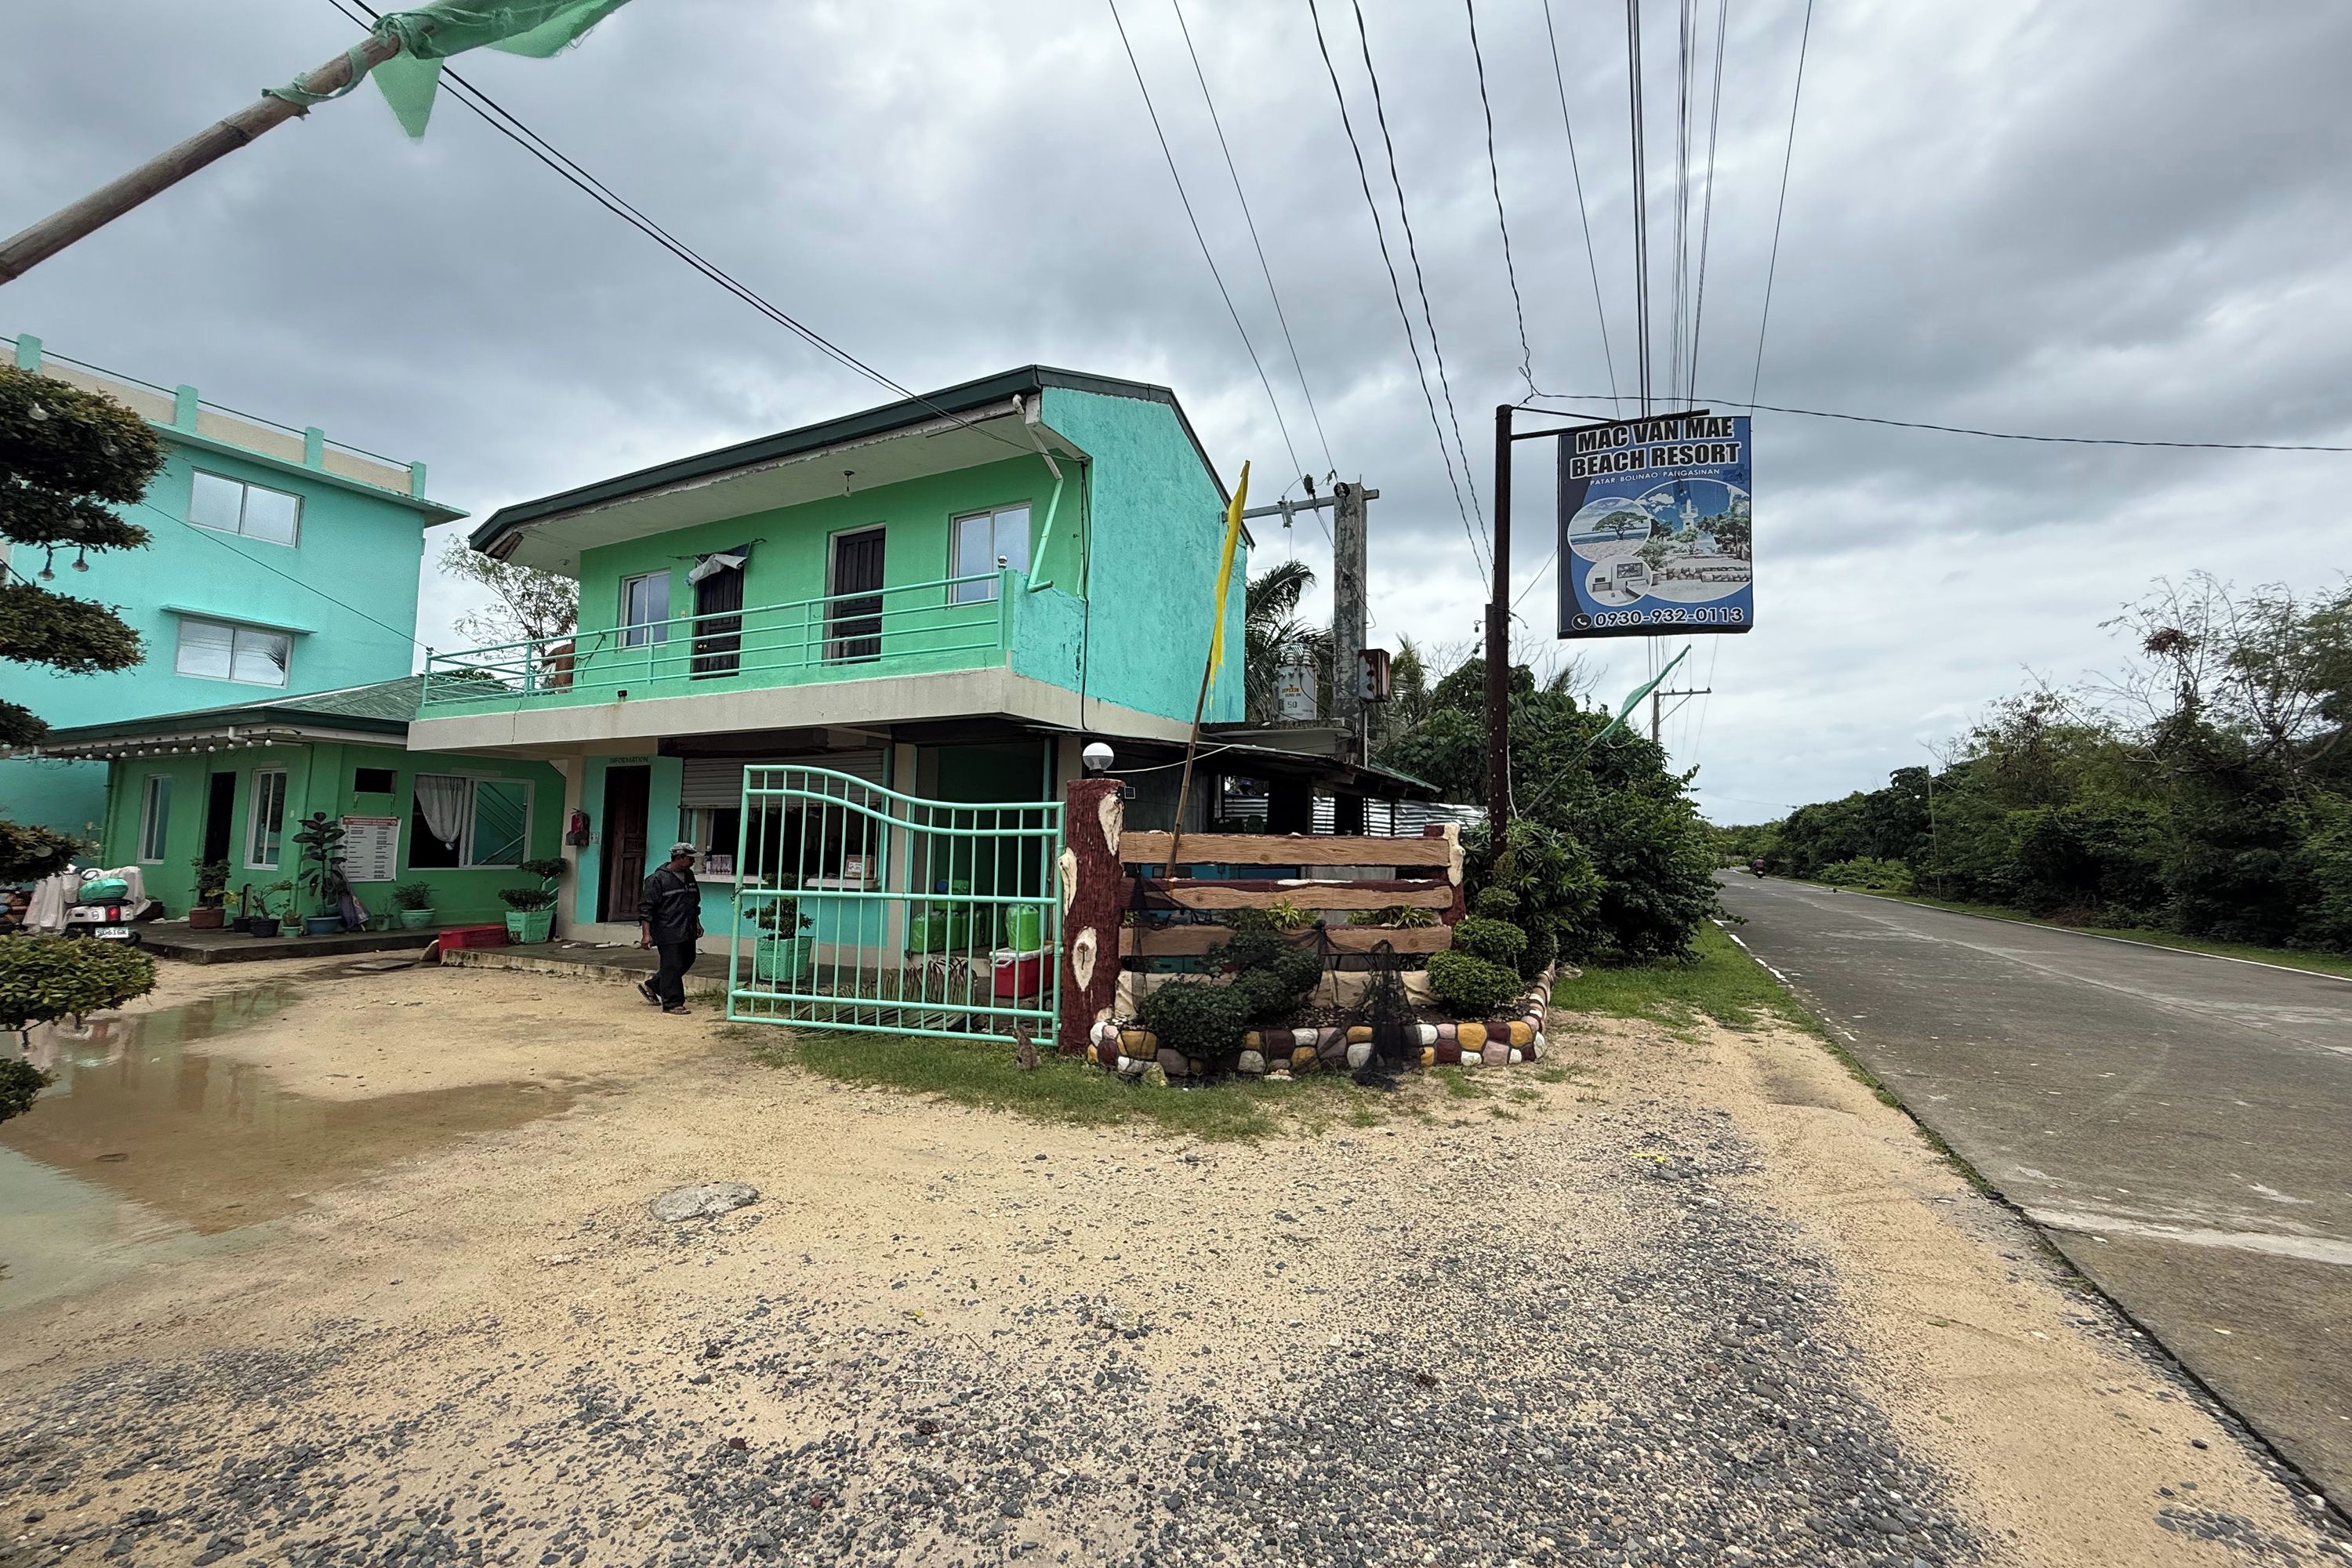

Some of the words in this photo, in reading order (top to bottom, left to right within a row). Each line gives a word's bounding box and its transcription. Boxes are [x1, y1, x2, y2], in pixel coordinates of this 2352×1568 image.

[1577, 426, 1628, 453] MAC
[1632, 420, 1679, 444] VAN
[1685, 417, 1734, 439] MAE
[1571, 449, 1646, 479] BEACH
[1650, 442, 1741, 468] RESORT
[1663, 469, 1720, 477] PANGASINAN
[1595, 608, 1743, 626] 0930-932-0113
